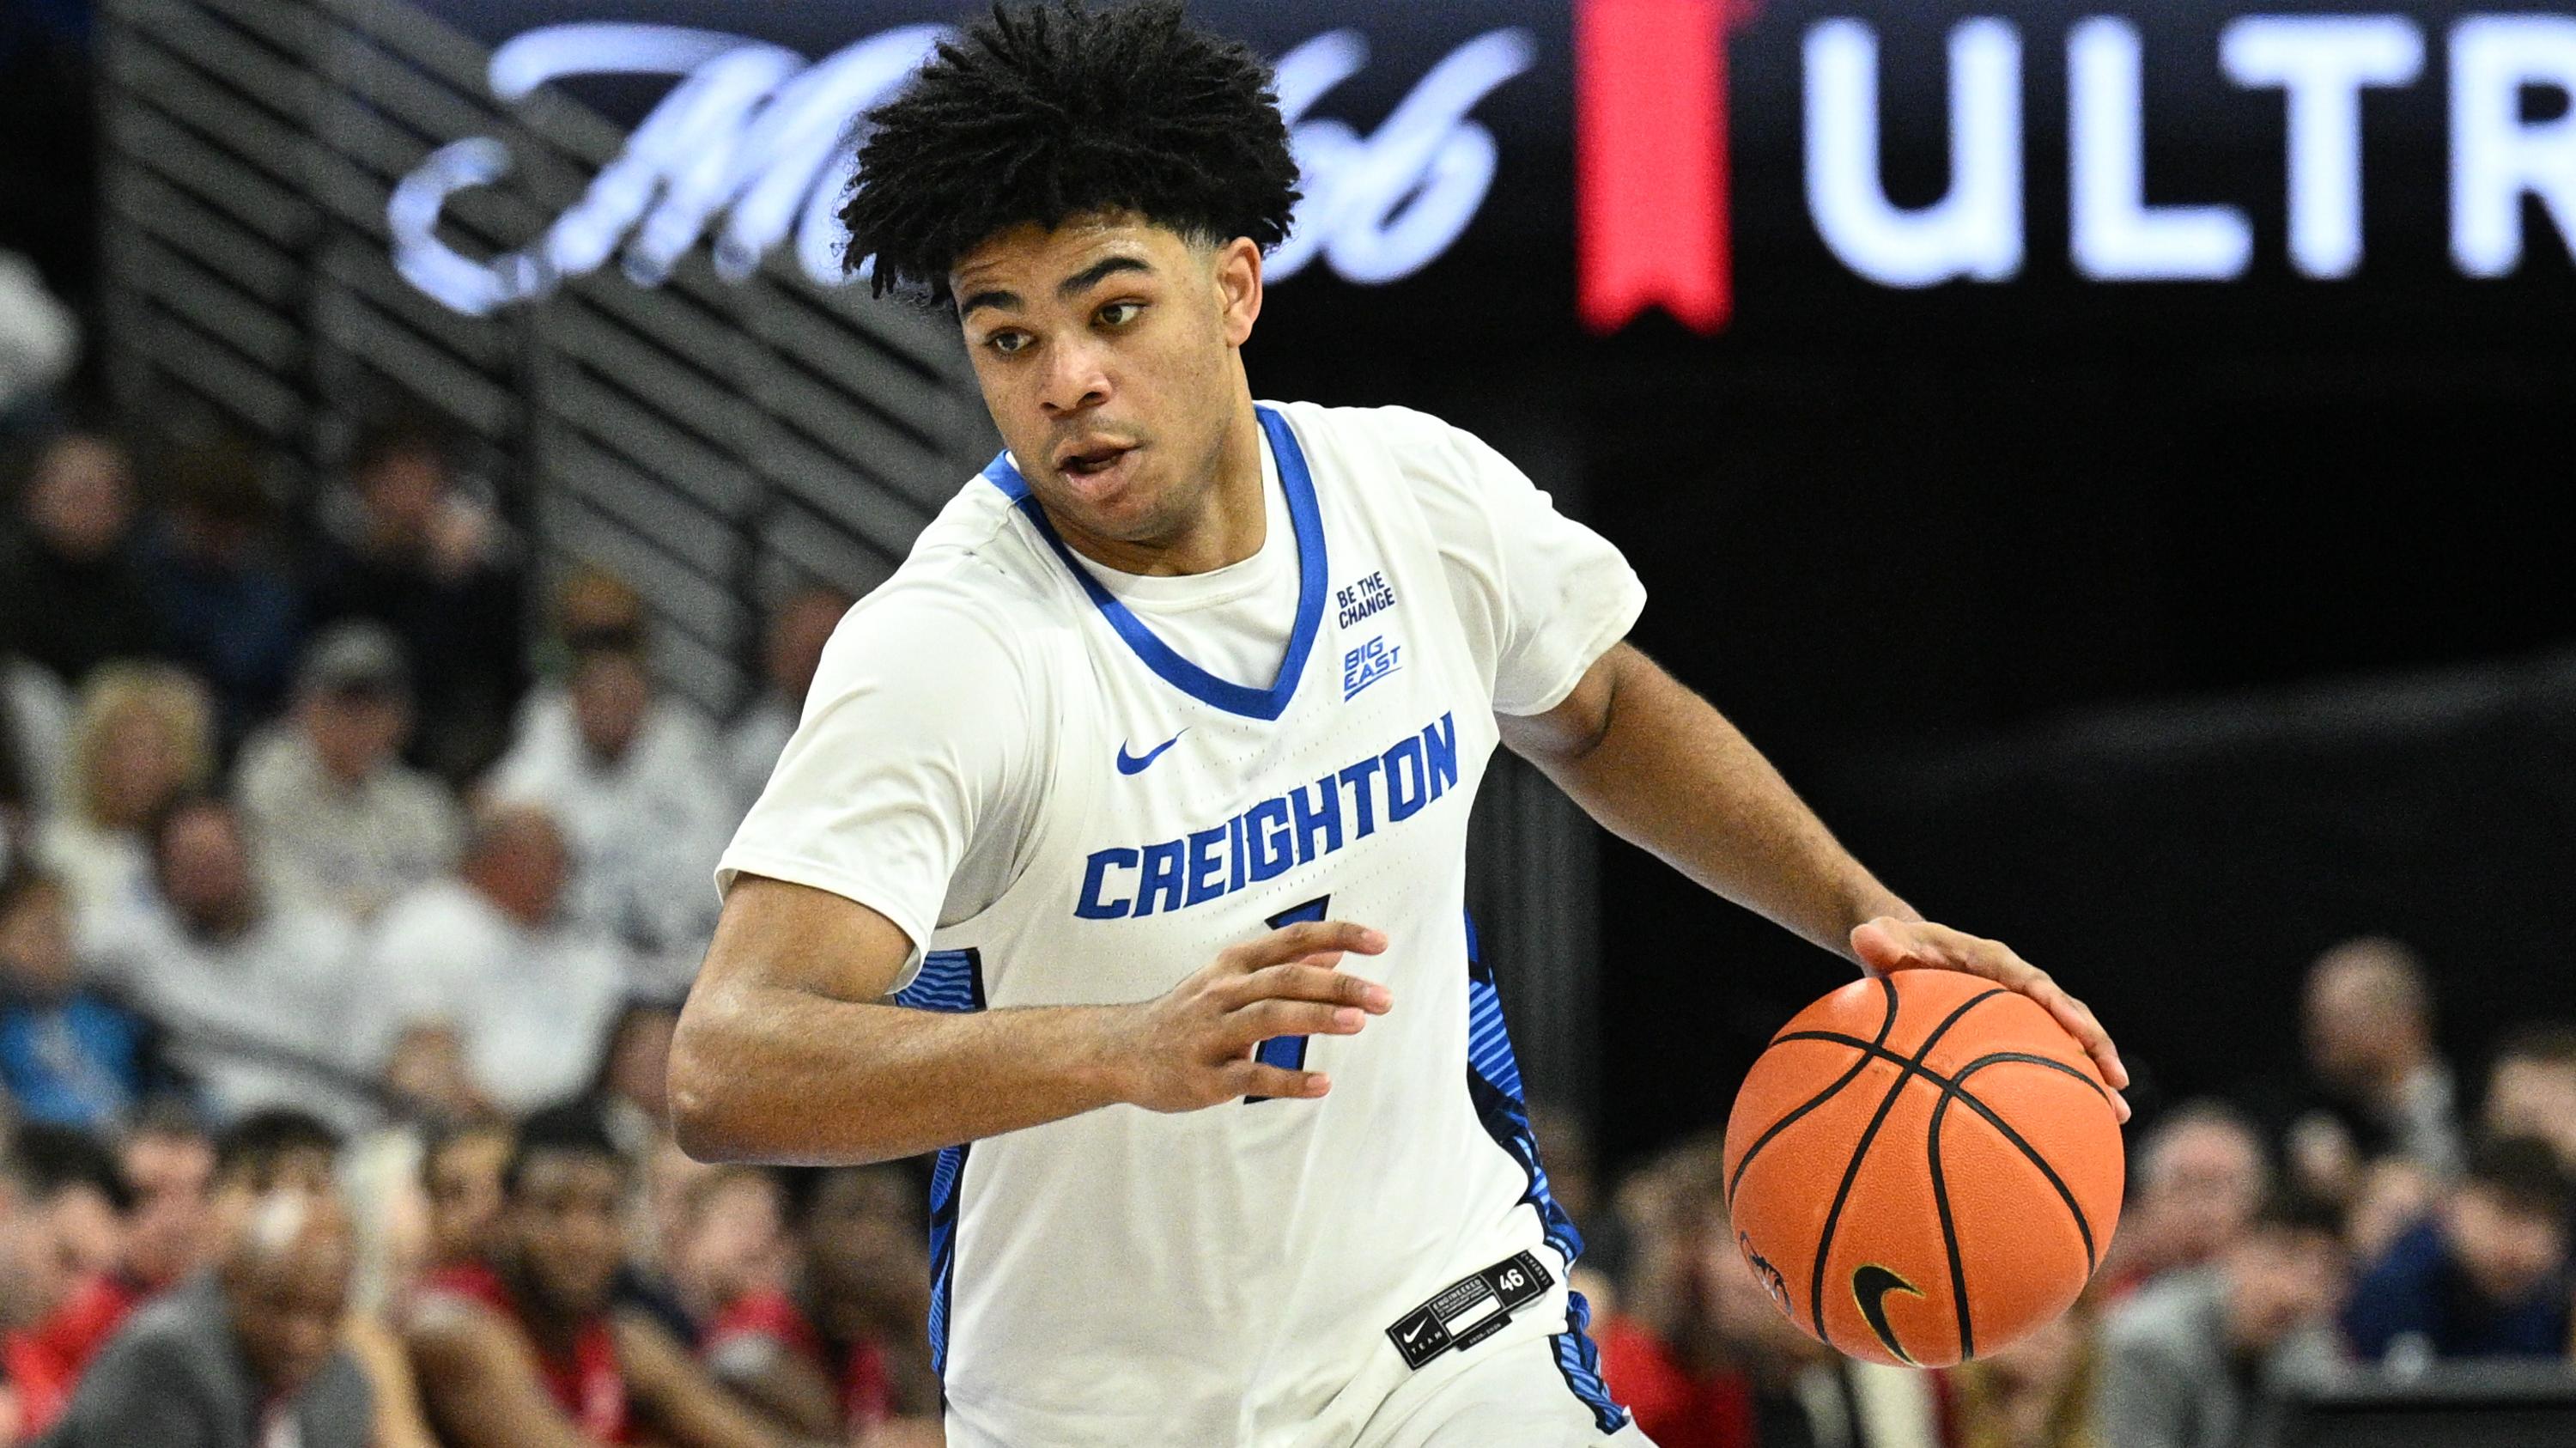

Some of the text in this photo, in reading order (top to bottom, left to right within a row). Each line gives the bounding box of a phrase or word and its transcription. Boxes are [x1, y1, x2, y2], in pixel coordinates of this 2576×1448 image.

[1801, 13, 2576, 288] ULTR
[1336, 571, 1385, 609] BE THE
[1339, 587, 1395, 630] CHANGE
[1344, 635, 1383, 672] BIG
[1344, 646, 1400, 691] EAST
[1073, 710, 1458, 919] CREIGHTON
[1432, 1279, 1481, 1311] ENGINEERED
[1499, 1269, 1524, 1292] 46
[1411, 1331, 1443, 1354] TEAM
